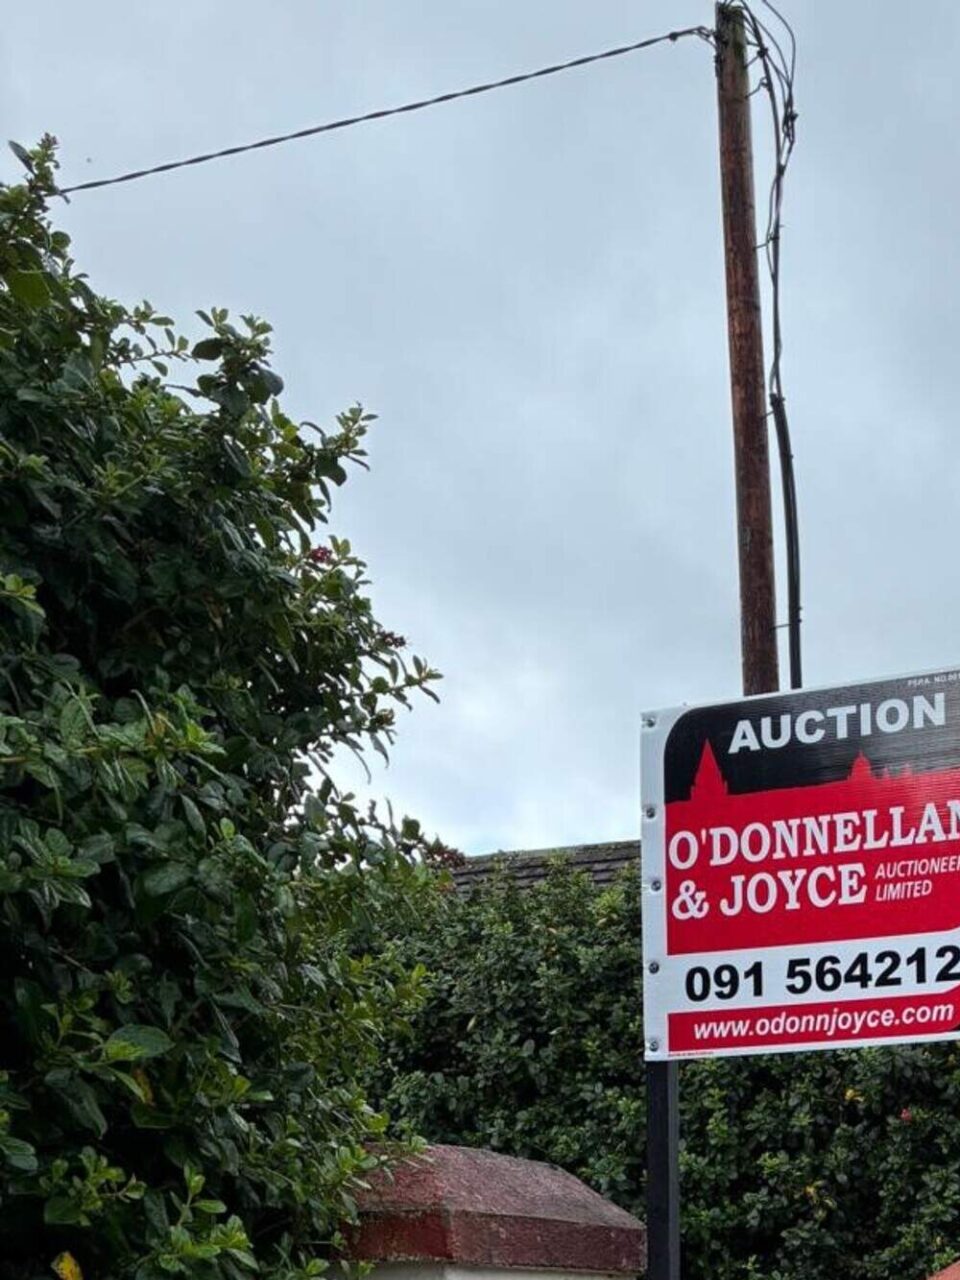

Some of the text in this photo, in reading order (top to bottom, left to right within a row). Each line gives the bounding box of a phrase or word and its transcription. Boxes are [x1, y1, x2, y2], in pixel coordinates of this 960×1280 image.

[728, 692, 945, 754] AUCTION
[671, 862, 868, 920] & JOYCE
[875, 879, 933, 901] LIMITED
[685, 961, 763, 1002] 091
[693, 1001, 955, 1041] www.odonnjoyce.com
